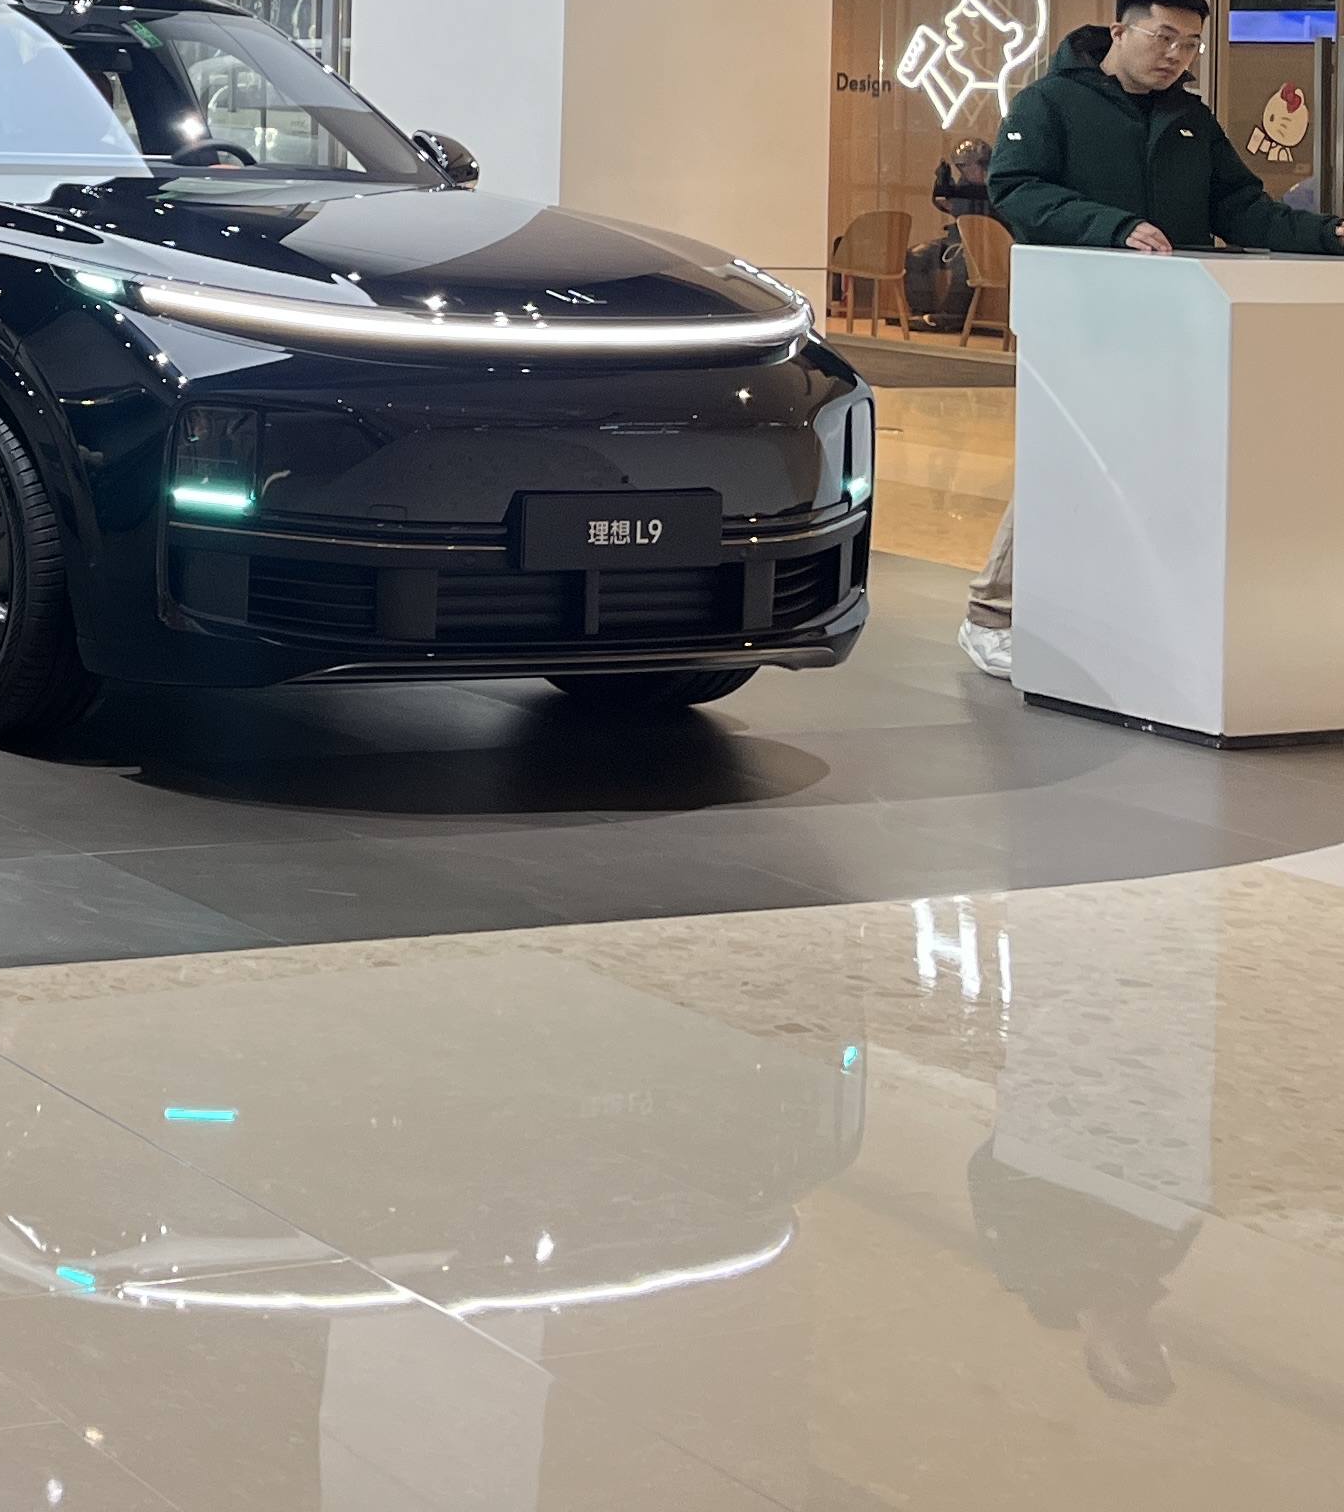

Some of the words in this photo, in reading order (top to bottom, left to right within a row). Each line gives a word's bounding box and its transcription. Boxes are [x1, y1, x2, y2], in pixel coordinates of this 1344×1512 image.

[836, 71, 892, 98] Design
[587, 519, 631, 545] 理想
[635, 519, 663, 545] L9
